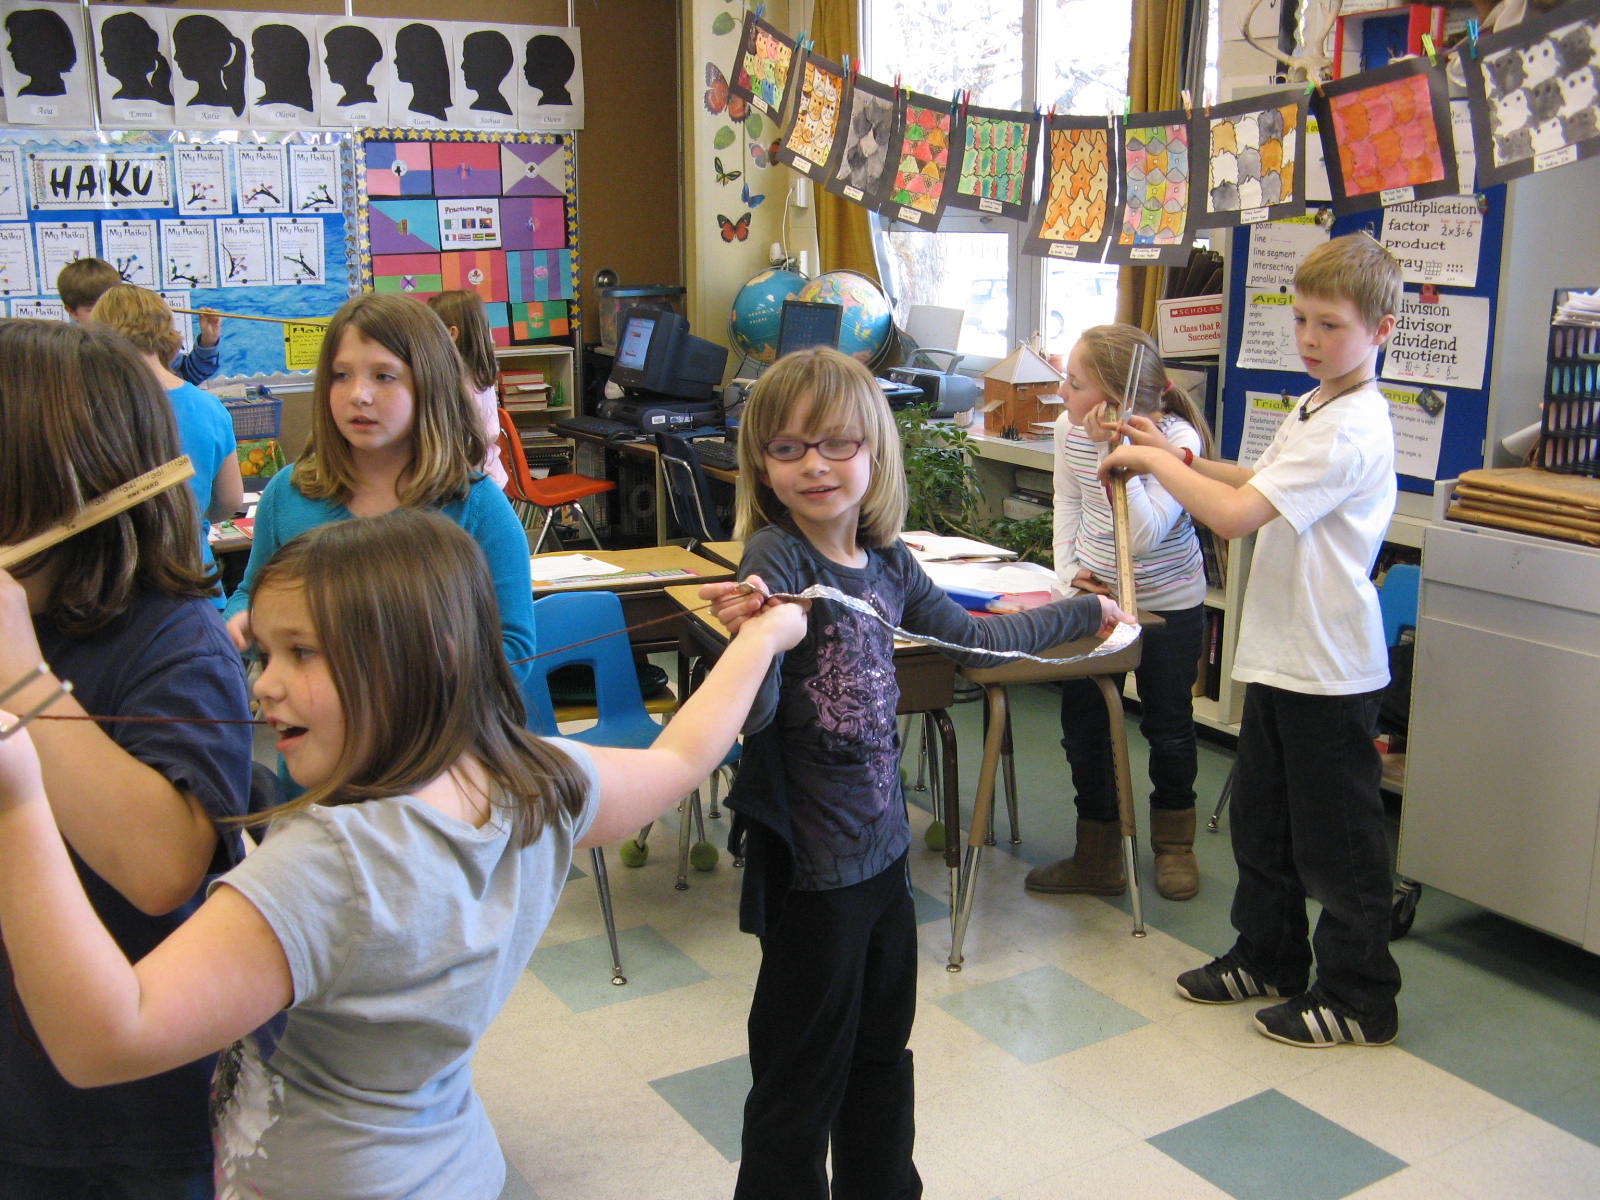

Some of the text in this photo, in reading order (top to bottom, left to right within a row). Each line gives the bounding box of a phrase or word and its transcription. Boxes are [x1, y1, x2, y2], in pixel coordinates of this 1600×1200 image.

[129, 110, 152, 119] Emma
[275, 110, 296, 119] Olivia
[182, 152, 220, 163] My Haiku
[242, 152, 278, 163] My Haiku
[297, 153, 332, 163] My Haiku
[50, 160, 152, 200] HAIKU
[1390, 200, 1477, 216] multiplication
[280, 225, 315, 235] My Haiku
[1388, 219, 1429, 231] factor
[45, 230, 85, 241] My Haiku
[109, 228, 148, 239] My Haiku
[168, 227, 206, 238] My Haiku
[225, 226, 260, 236] My Haiku
[1254, 234, 1266, 243] line
[1385, 239, 1446, 251] product
[1253, 248, 1295, 259] line segment
[1253, 262, 1294, 274] intersecting
[1395, 259, 1423, 272] ray
[1251, 275, 1277, 284] parallel
[1253, 295, 1293, 305] Angl
[35, 308, 59, 316] Haiku
[1179, 305, 1221, 316] SCHOLAS
[1180, 324, 1198, 333] Class
[1199, 322, 1214, 332] that
[1395, 316, 1452, 333] divisor
[1188, 331, 1221, 342] Succeeds
[1392, 332, 1457, 351] dividend
[1391, 349, 1457, 365] quotient
